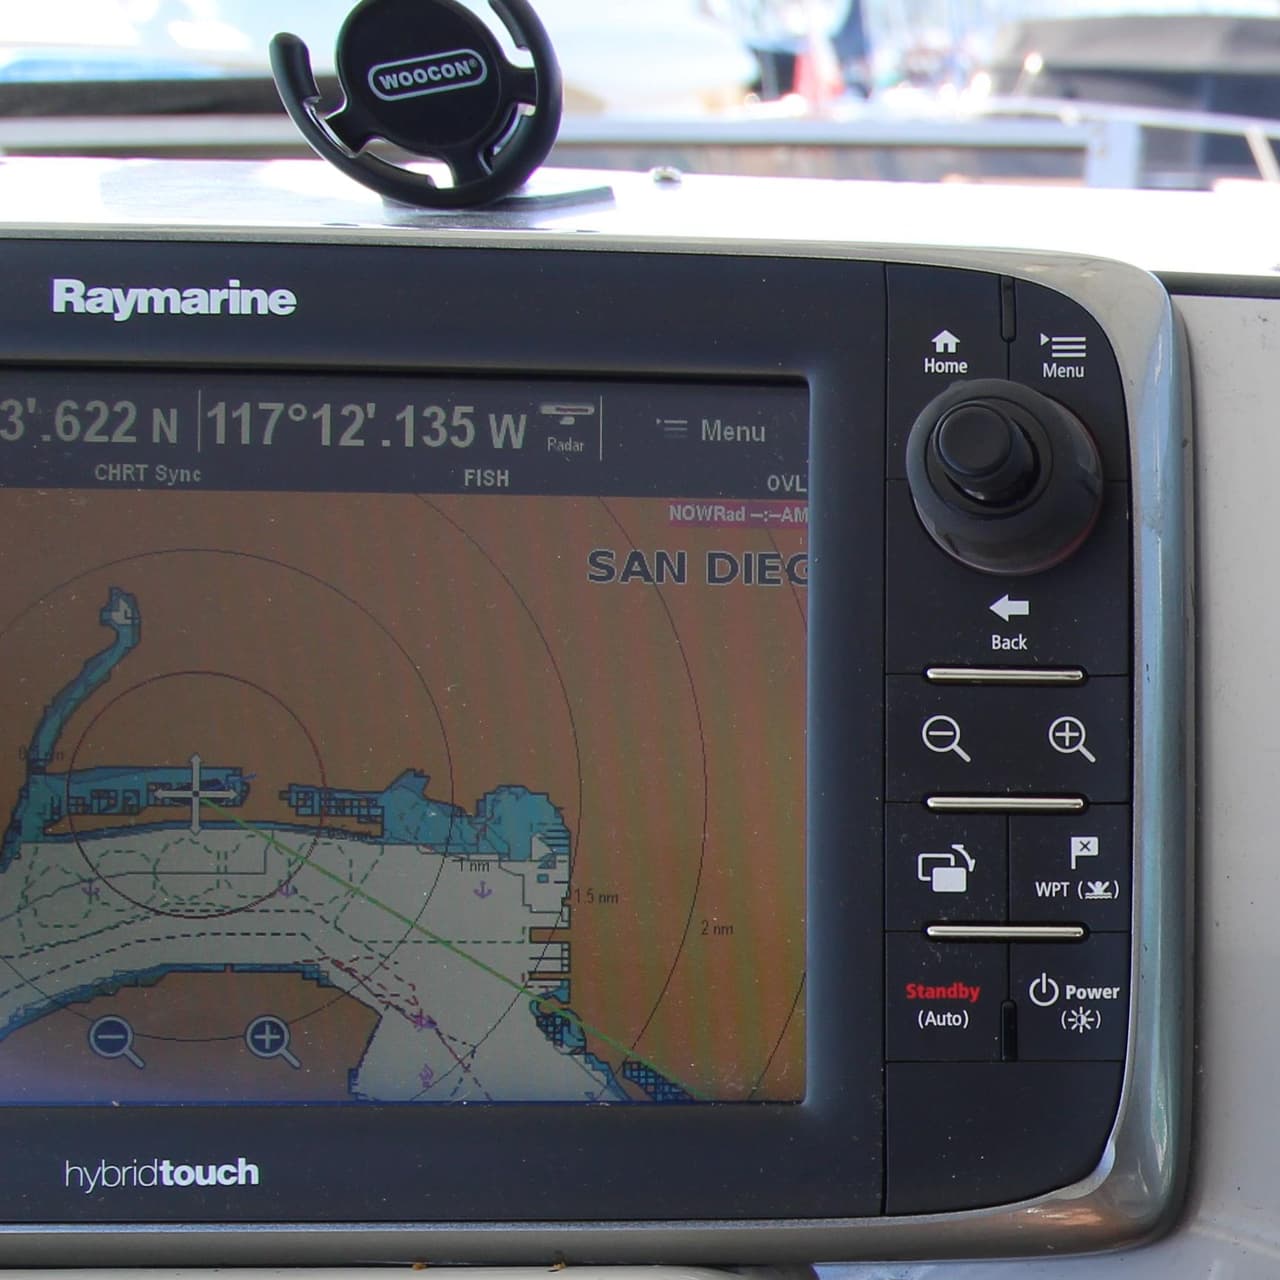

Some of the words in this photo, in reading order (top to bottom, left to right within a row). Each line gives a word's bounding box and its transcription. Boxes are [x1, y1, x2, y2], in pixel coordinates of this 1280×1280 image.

[53, 278, 297, 321] Raymarine
[924, 358, 968, 374] Home
[1042, 363, 1085, 379] Menu
[152, 408, 178, 443] N
[489, 413, 528, 449] W
[701, 419, 766, 443] Menu
[547, 436, 584, 452] Radar
[95, 464, 148, 482] CHRT
[155, 464, 200, 486] Sync
[464, 469, 510, 487] FISH
[669, 504, 746, 522] NOWRad
[587, 549, 688, 586] SAN
[991, 634, 1028, 650] Back
[1035, 881, 1070, 897] WPT
[906, 983, 981, 1003] Standby
[1065, 984, 1120, 1001] Power
[918, 1010, 969, 1030] (Auto)
[64, 1158, 259, 1193] hybridtouch
